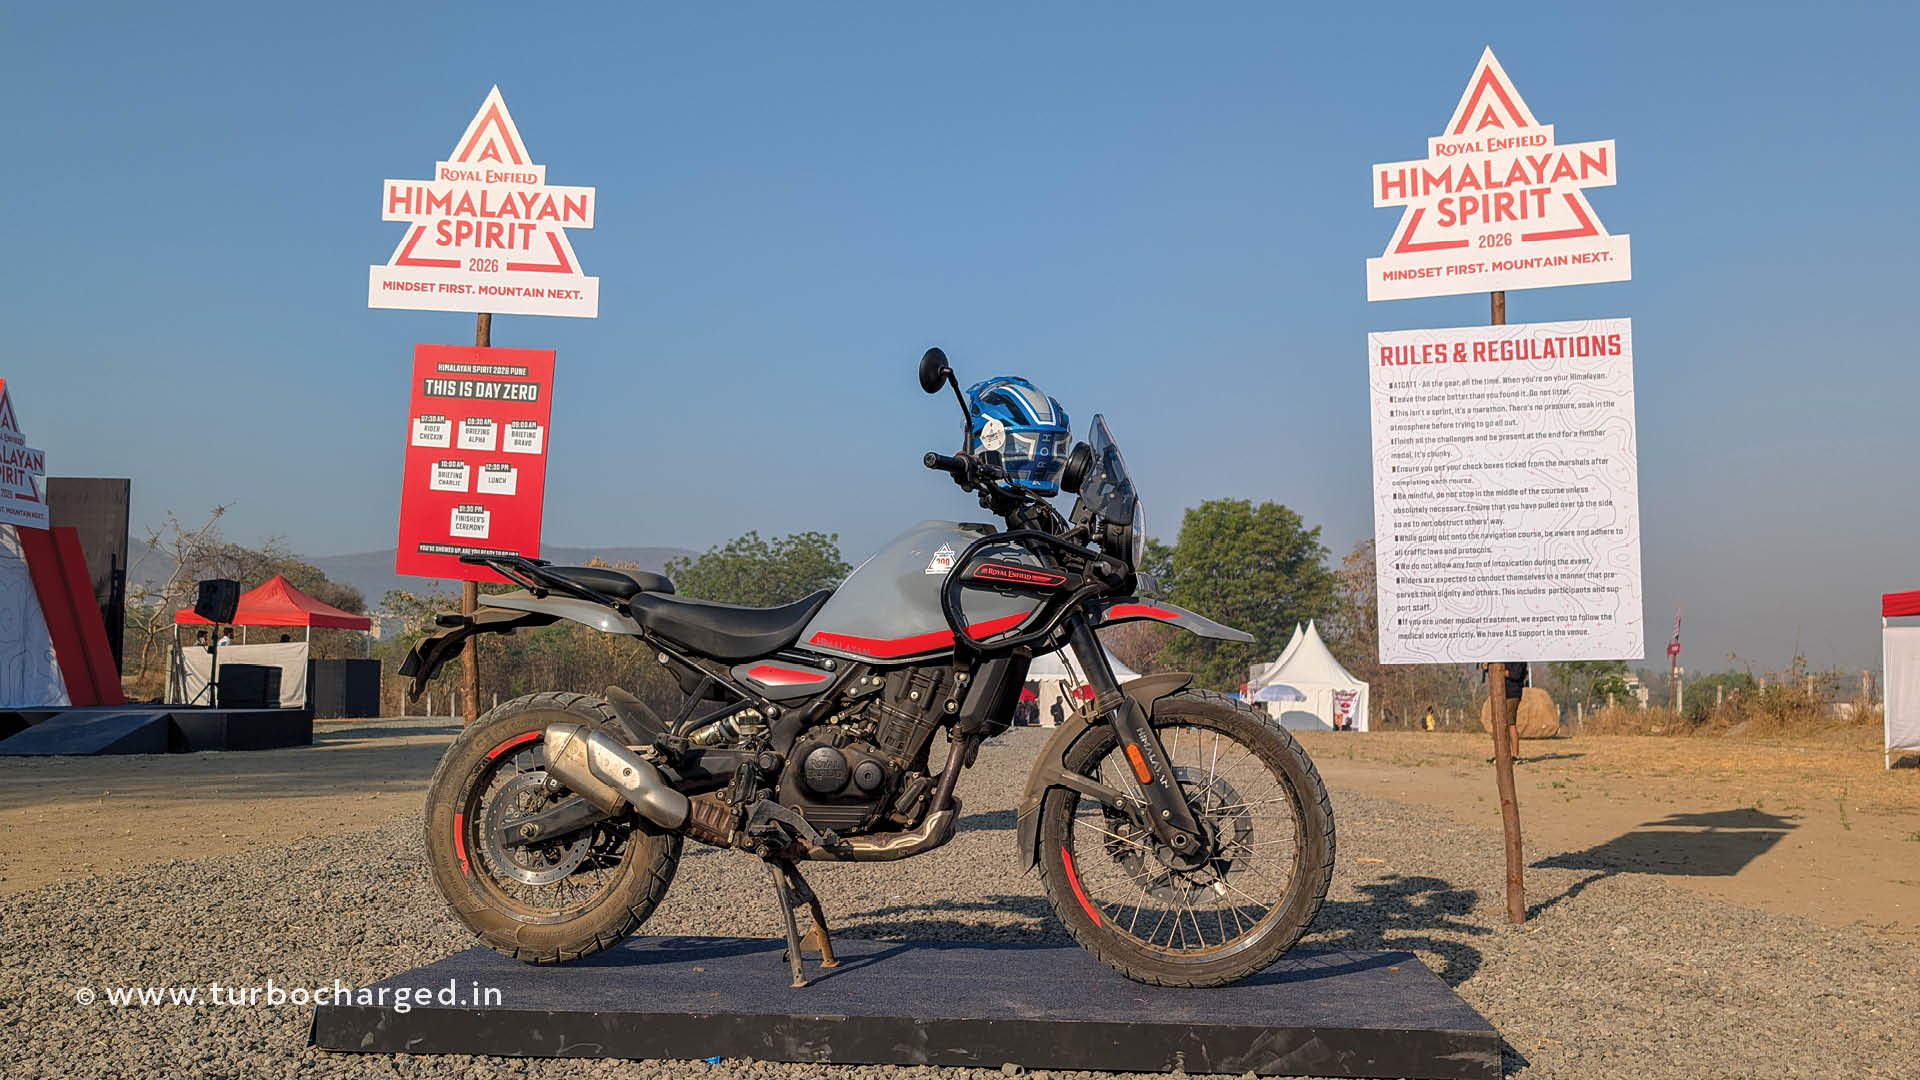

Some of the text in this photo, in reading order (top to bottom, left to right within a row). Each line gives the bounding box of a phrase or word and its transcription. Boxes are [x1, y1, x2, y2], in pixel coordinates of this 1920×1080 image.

[1436, 135, 1546, 157] ROYAL ENFIELD
[441, 168, 537, 184] ROYAL ENFIELD
[1381, 147, 1607, 200] HIMALAYAN
[389, 186, 587, 222] HIMALAYAN
[1437, 188, 1551, 227] SPIRIT
[436, 220, 536, 250] SPIRIT
[1479, 233, 1512, 248] 2026
[469, 258, 498, 272] 2026
[1383, 252, 1613, 281] MINDSET FIRST. MOUNTAIN NEXT.
[382, 281, 583, 300] MINDSET FIRST. MOUNTAIN NEXT.
[1381, 334, 1620, 366] RULES & REGULATIONS
[438, 364, 471, 372] HIMALAYAN
[426, 380, 537, 400] THIS IS DAY ZERO
[1393, 506, 1428, 515] absolutely
[1538, 501, 1559, 510] pulled
[1534, 558, 1556, 567] during
[1436, 575, 1467, 584] expected
[1396, 604, 1411, 612] port
[1482, 615, 1519, 624] treatment,
[1531, 614, 1554, 623] expect
